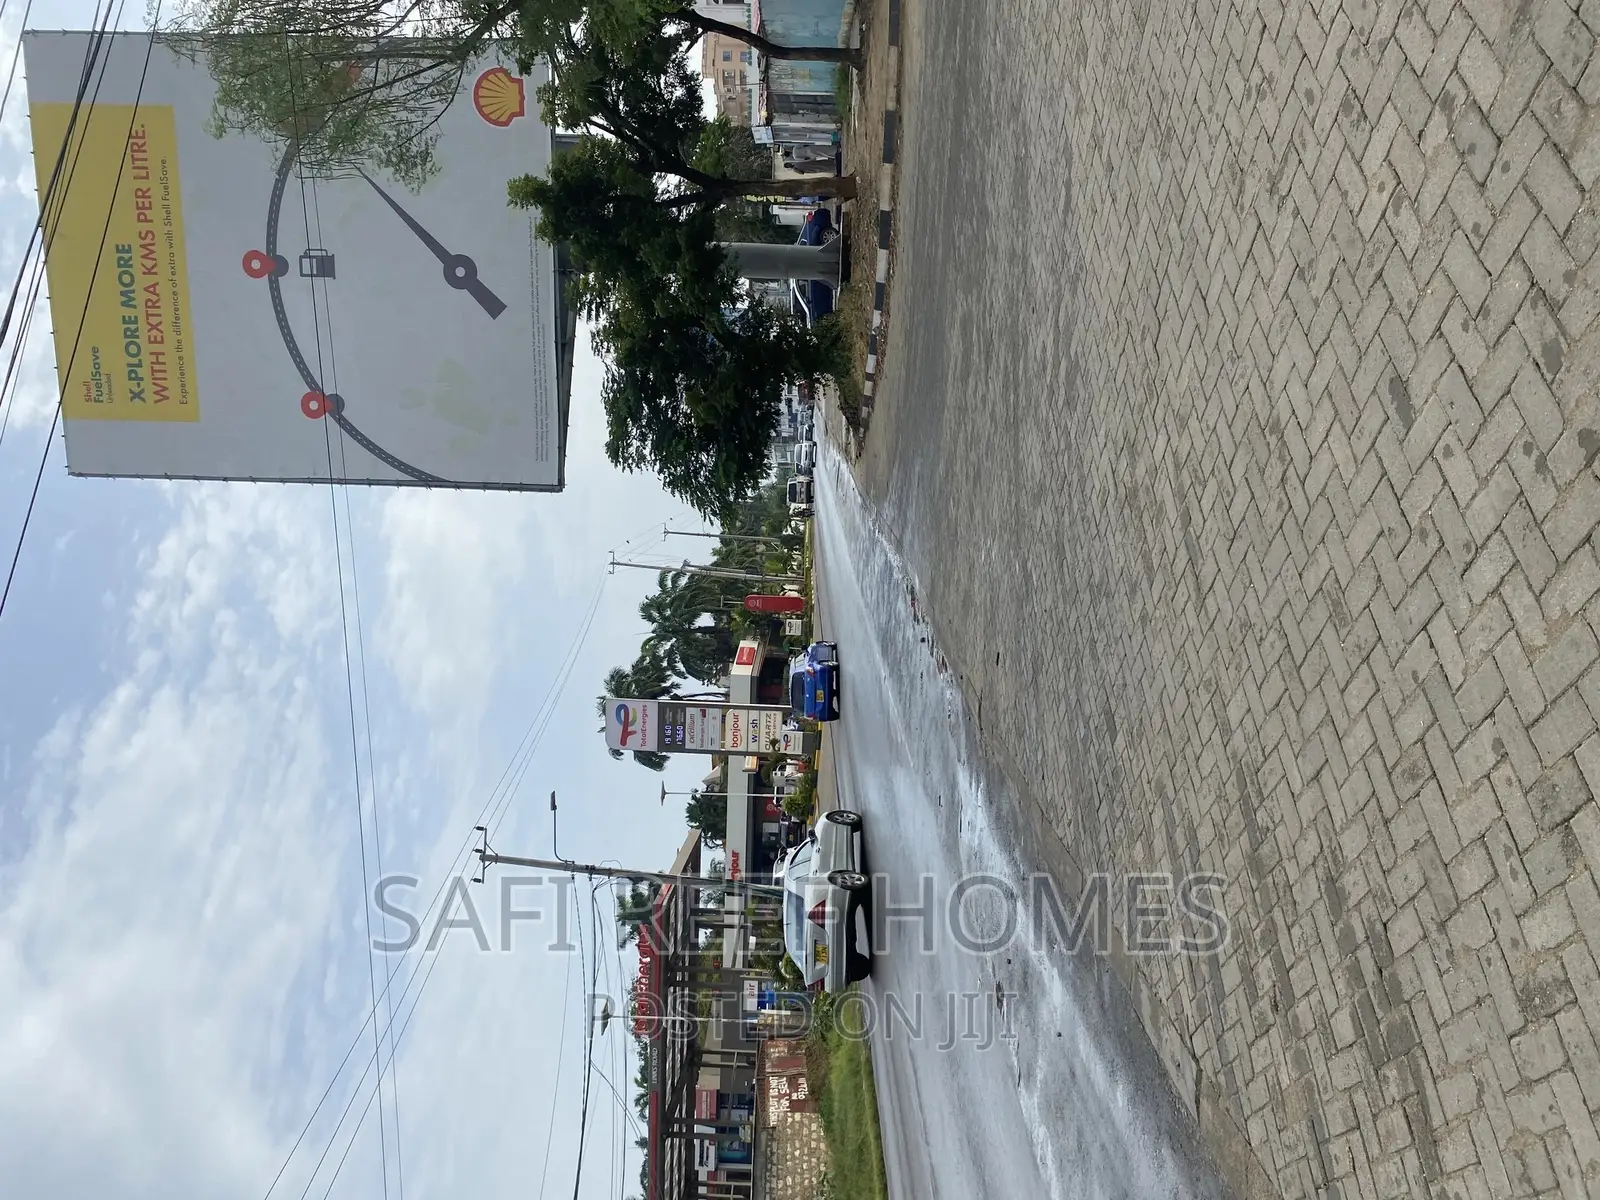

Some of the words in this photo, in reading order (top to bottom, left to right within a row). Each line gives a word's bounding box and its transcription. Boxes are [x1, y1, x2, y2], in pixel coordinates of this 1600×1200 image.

[130, 124, 150, 180] LITRE.
[160, 156, 170, 201] FuelSave.
[134, 188, 154, 223] PER
[162, 204, 172, 226] Shell
[138, 230, 158, 276] KMS
[165, 230, 174, 248] with
[115, 244, 137, 309] MORE
[168, 252, 176, 276] extra
[168, 278, 178, 288] of
[143, 282, 164, 344] EXTRA
[171, 291, 182, 336] difference
[122, 315, 146, 403] X-PLORE
[174, 339, 183, 352] the
[83, 381, 92, 402] Shell
[91, 346, 104, 403] FuelSave
[104, 374, 113, 404] Unleaded
[149, 352, 170, 404] WITH
[178, 356, 188, 404] Experience
[640, 704, 648, 747] TotalEnergies
[730, 713, 741, 748] bonjour
[750, 719, 758, 743] wash
[764, 713, 772, 750] QUARTZ
[746, 984, 755, 996] air
[769, 1076, 778, 1088] NOT
[778, 1077, 790, 1094] SELL
[780, 1096, 790, 1111] FOR
